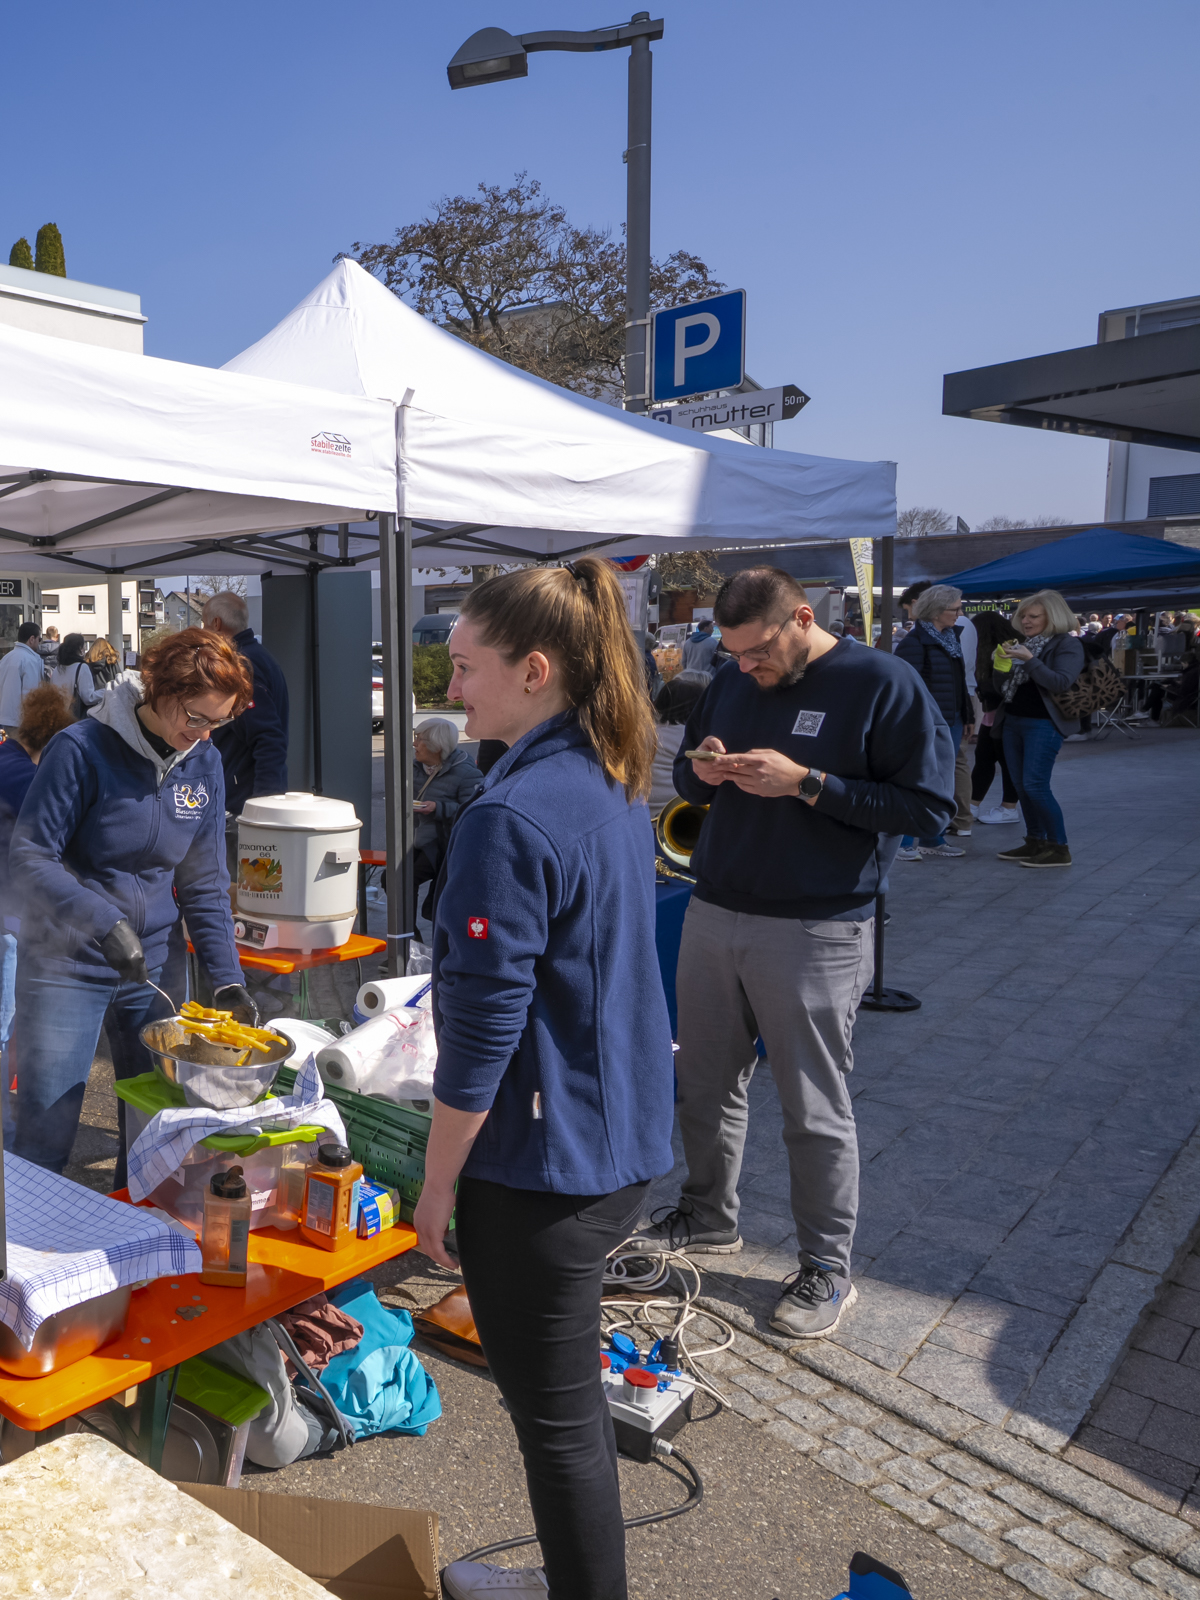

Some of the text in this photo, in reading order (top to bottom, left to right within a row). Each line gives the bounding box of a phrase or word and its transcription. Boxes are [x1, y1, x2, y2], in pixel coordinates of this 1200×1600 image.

[674, 312, 721, 387] P
[678, 402, 728, 417] schuhhaus
[691, 402, 776, 428] mutter
[311, 440, 352, 453] stabile zelte
